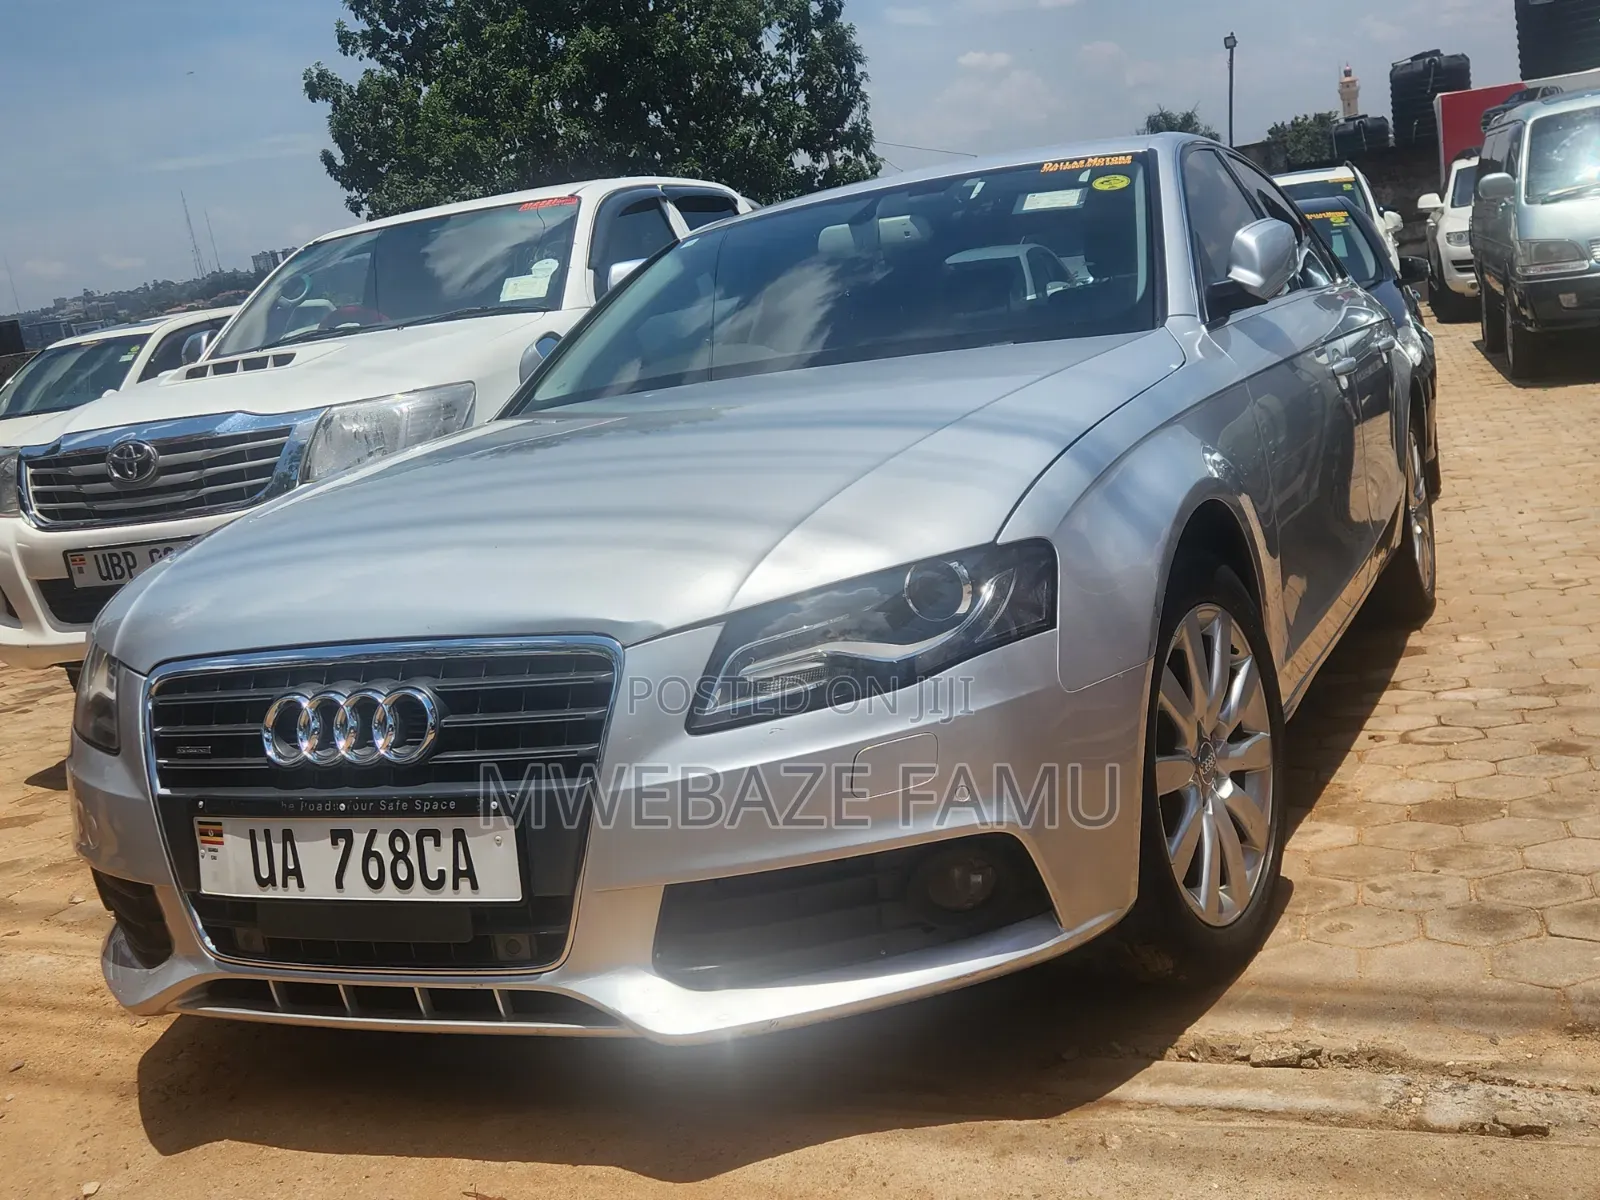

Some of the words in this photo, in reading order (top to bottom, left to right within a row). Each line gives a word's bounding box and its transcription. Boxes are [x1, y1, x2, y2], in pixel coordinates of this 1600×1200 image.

[94, 551, 138, 582] UBP
[379, 799, 409, 811] Safe
[414, 799, 456, 812] Space
[248, 828, 306, 889] UA
[329, 828, 480, 891] 768CA
